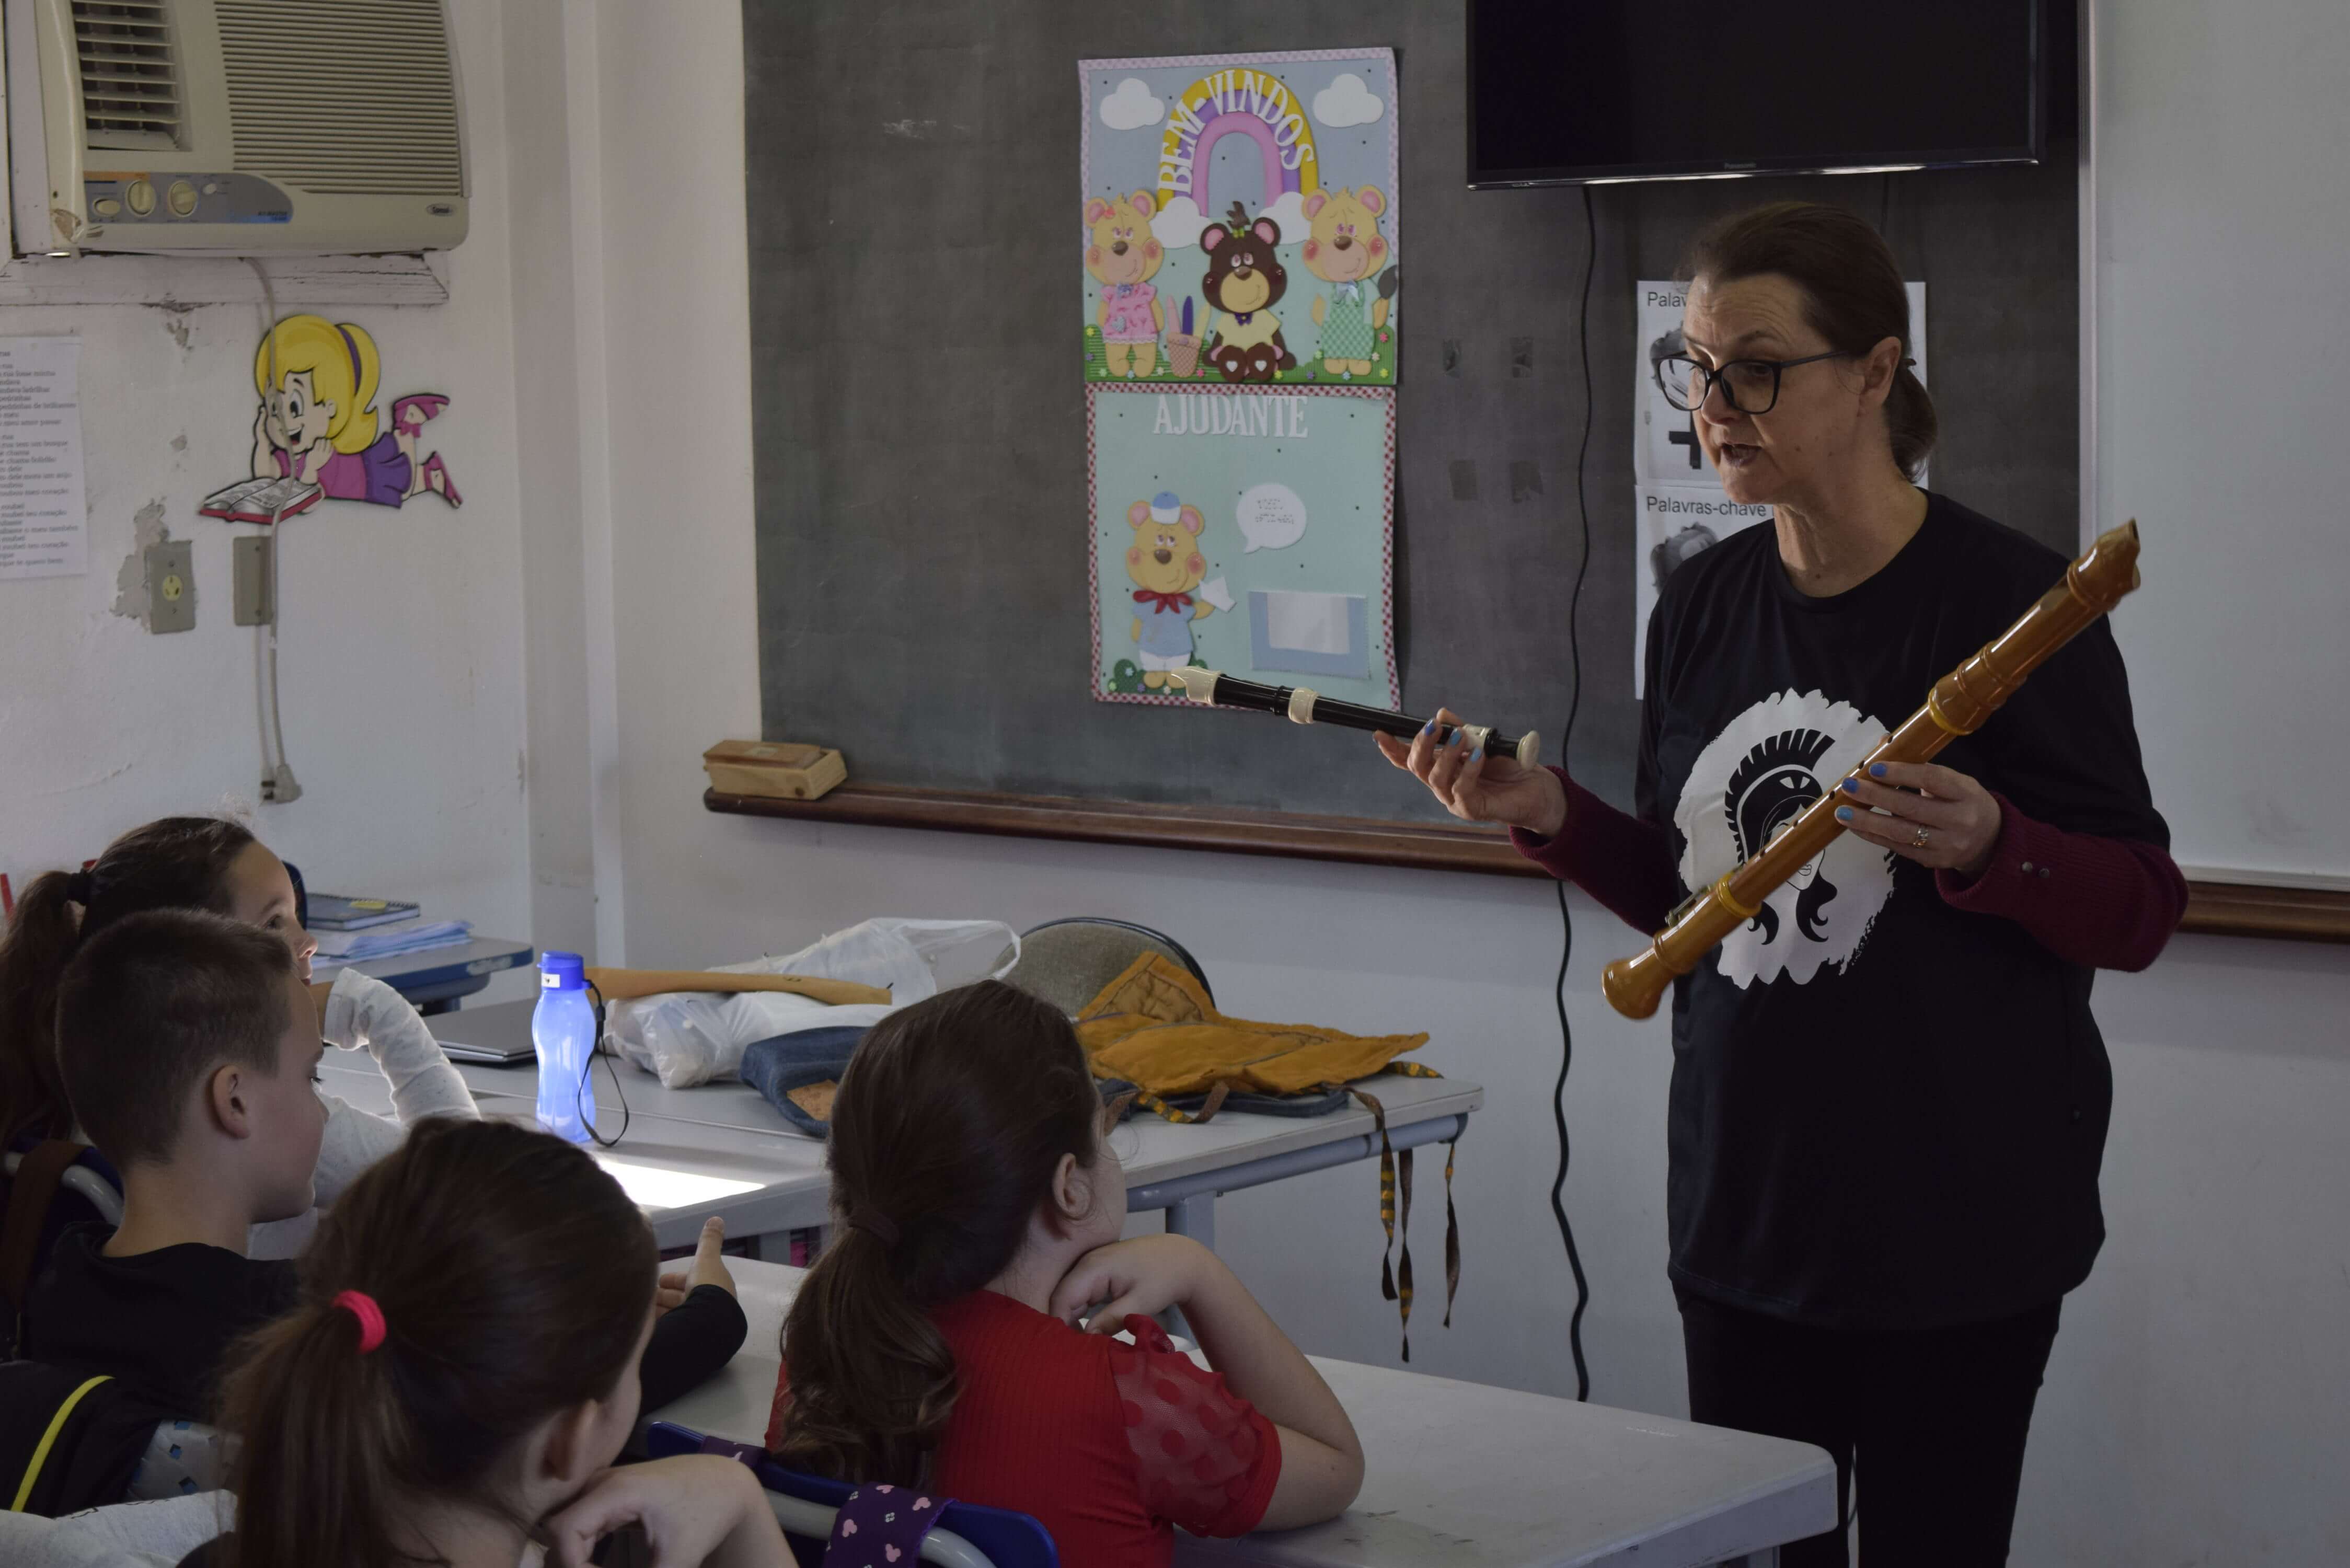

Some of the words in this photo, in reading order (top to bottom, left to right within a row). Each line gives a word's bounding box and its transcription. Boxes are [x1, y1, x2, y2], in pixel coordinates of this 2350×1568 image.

[1158, 70, 1315, 194] BEM-VINDOS
[1648, 292, 1687, 307] Palav
[1153, 394, 1308, 439] AJUDANTE
[1646, 496, 1767, 516] Palavras-chave
